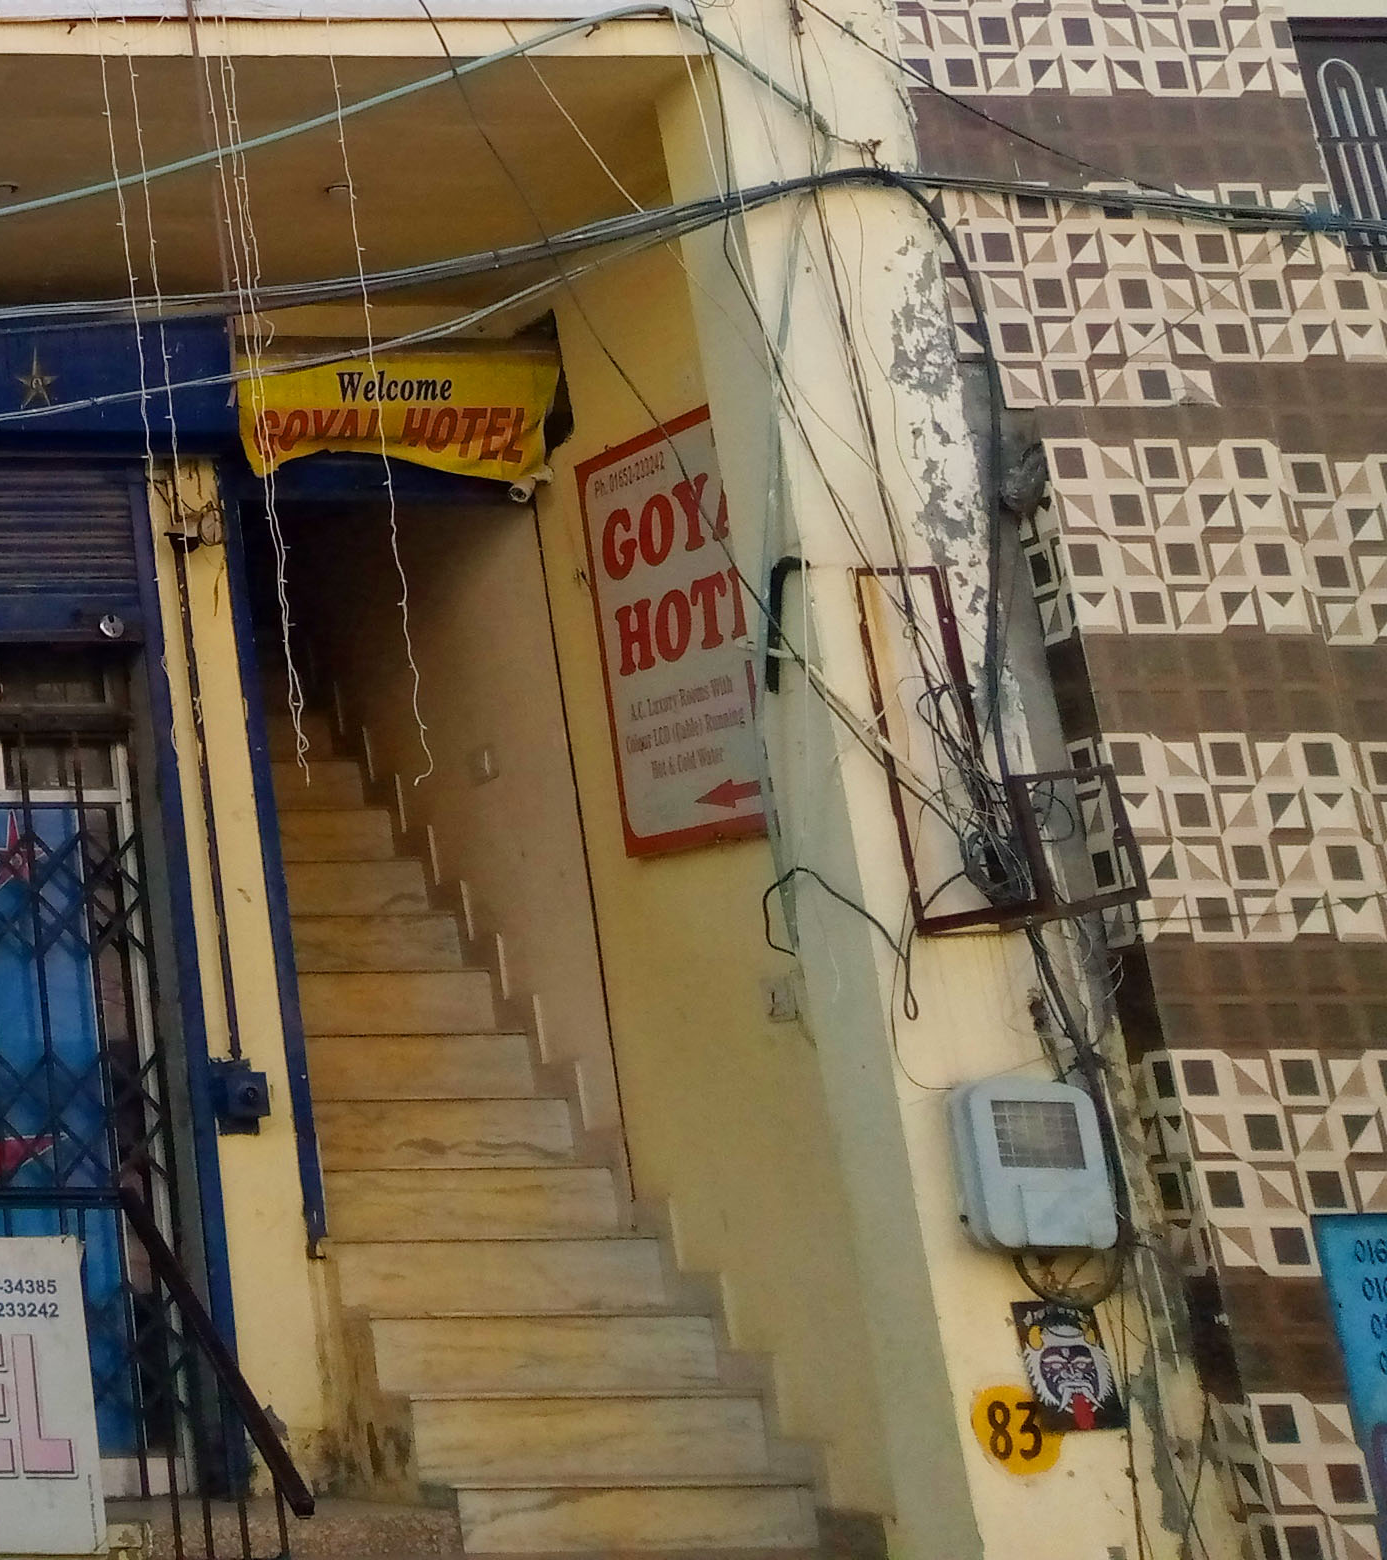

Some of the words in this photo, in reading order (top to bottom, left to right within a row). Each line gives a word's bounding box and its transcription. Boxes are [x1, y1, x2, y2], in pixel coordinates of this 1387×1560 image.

[337, 371, 453, 404] Welcome
[396, 407, 528, 465] HOTEL
[986, 1398, 1044, 1462] 83
